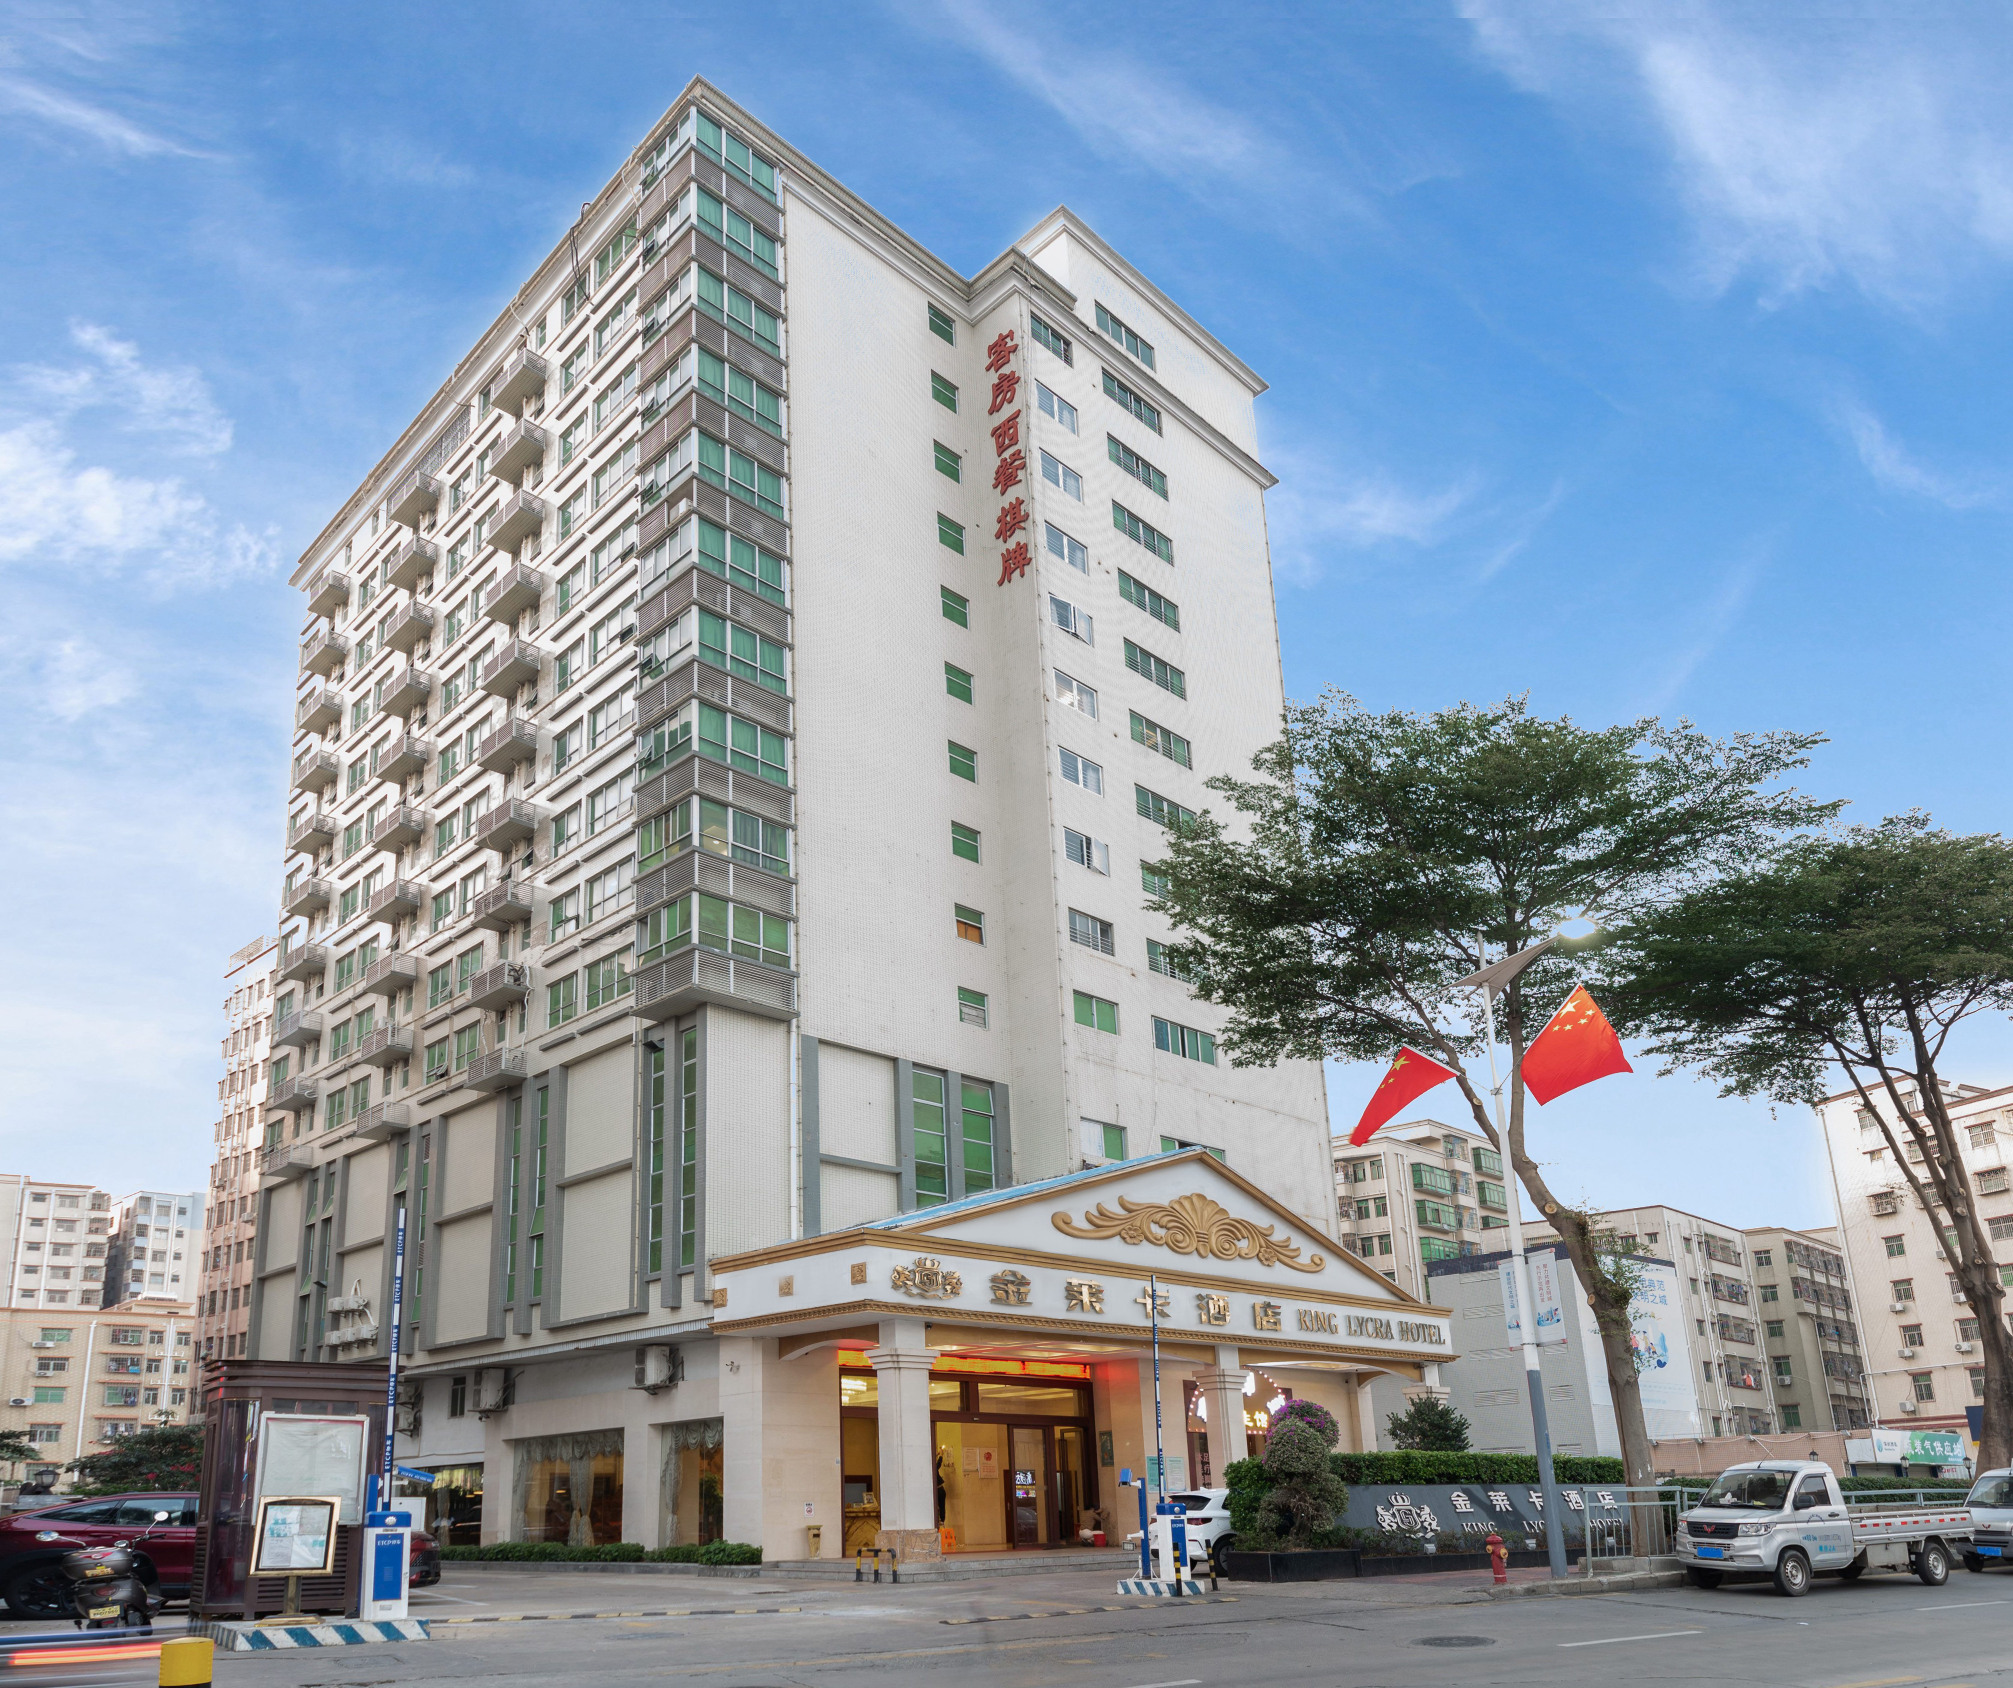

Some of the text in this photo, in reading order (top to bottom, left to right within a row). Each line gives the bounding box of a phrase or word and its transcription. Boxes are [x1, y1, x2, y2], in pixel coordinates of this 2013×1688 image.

[985, 329, 1032, 586] 客房西餐棋牌
[989, 1269, 1282, 1332] 金莱卡酒店
[1298, 1308, 1446, 1345] KING LYCRA HOTEL
[1242, 1409, 1269, 1428] 生馆
[1450, 1490, 1617, 1513] 金莱卡酒店
[1462, 1521, 1497, 1535] KING
